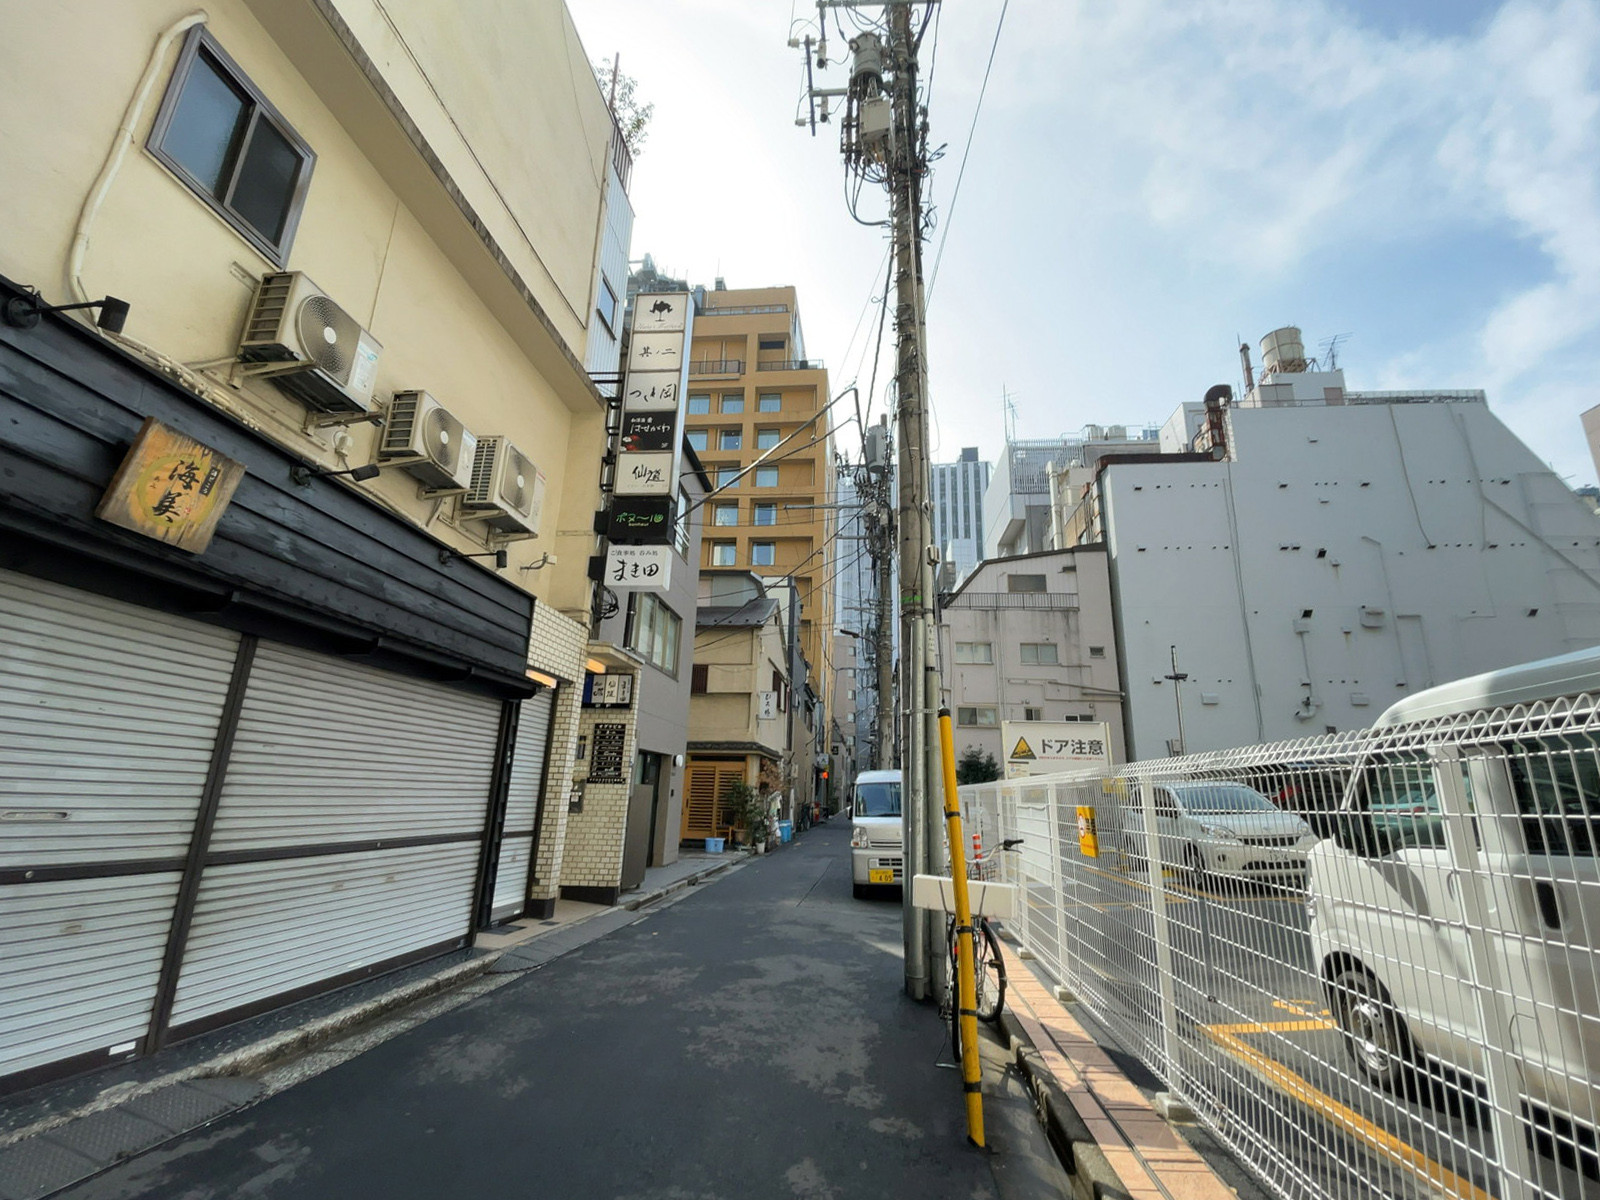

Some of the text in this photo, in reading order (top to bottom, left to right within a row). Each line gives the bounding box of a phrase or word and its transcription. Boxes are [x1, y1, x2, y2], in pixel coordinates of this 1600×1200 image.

[612, 559, 660, 581] まき田
[1041, 739, 1104, 755] ドア注意
